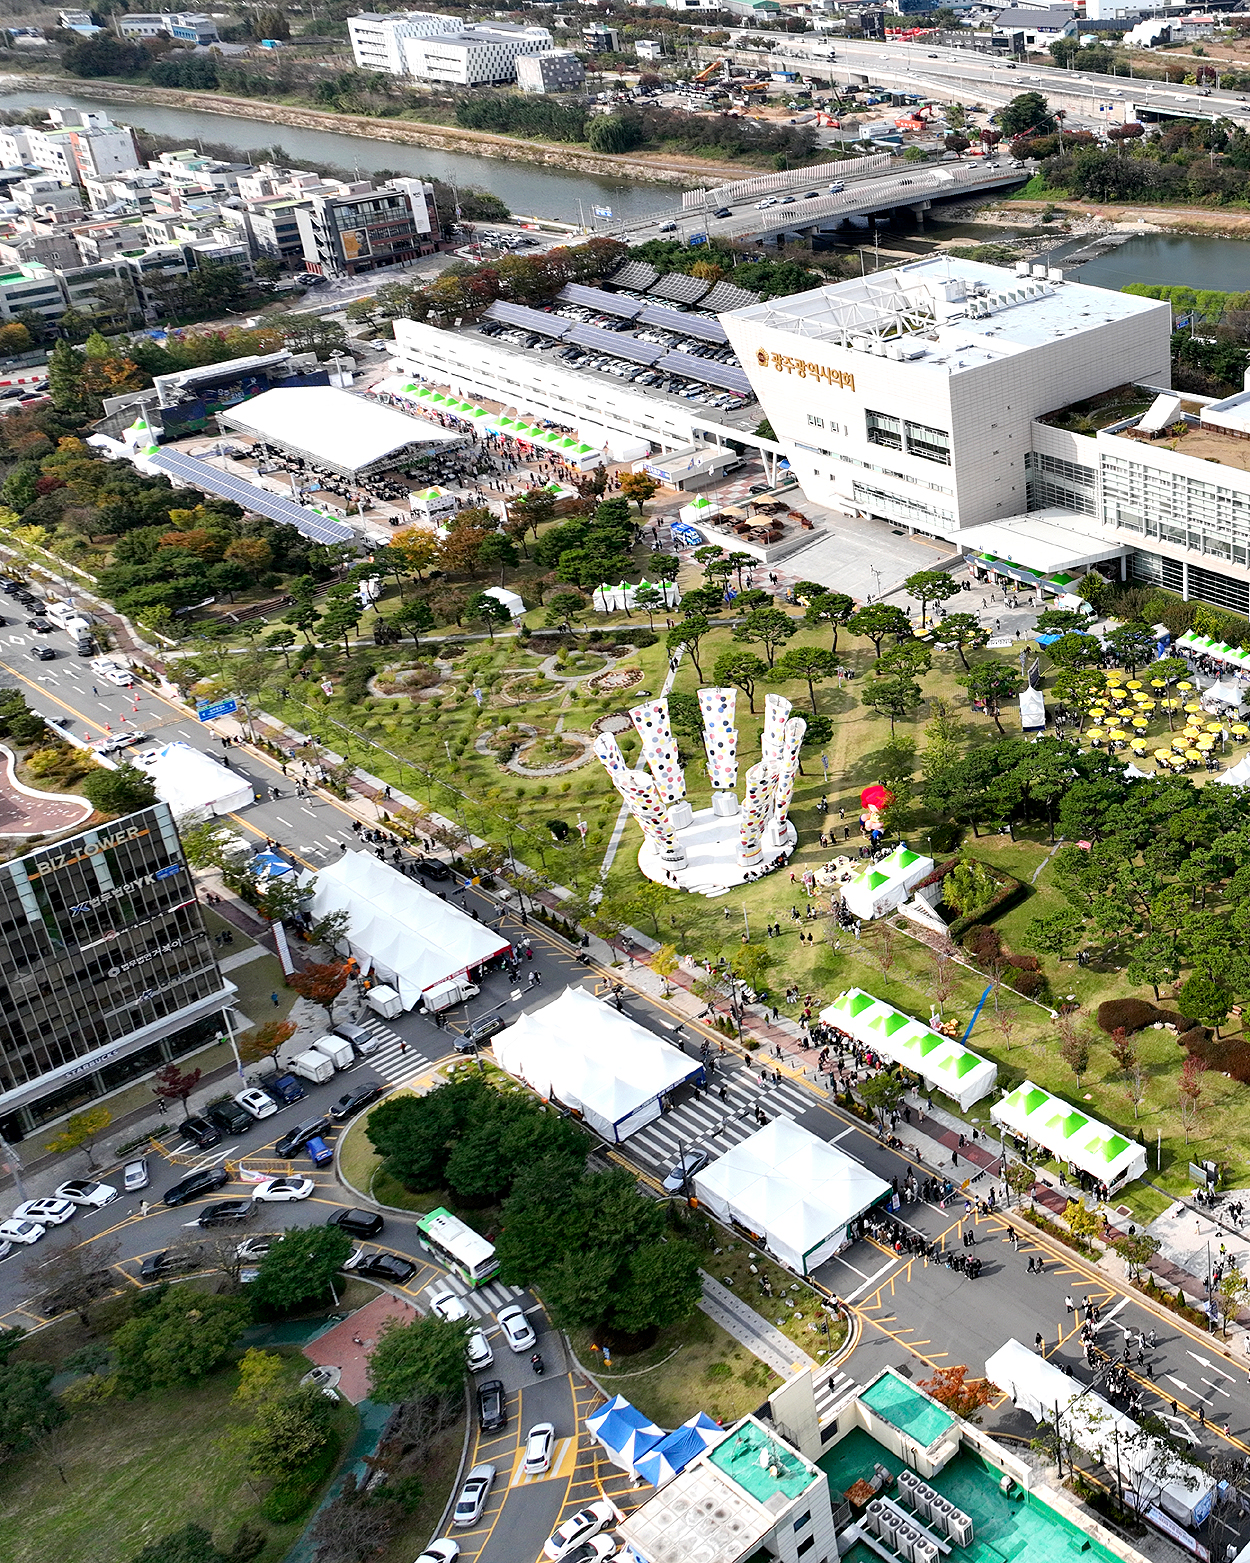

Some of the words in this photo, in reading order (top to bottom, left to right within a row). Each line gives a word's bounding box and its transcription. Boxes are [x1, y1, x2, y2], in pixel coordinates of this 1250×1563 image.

[771, 352, 856, 393] 광주광역시의회
[36, 855, 70, 877] BIZ
[71, 825, 141, 860] TOWER
[64, 1049, 119, 1078] STARBUCKS
